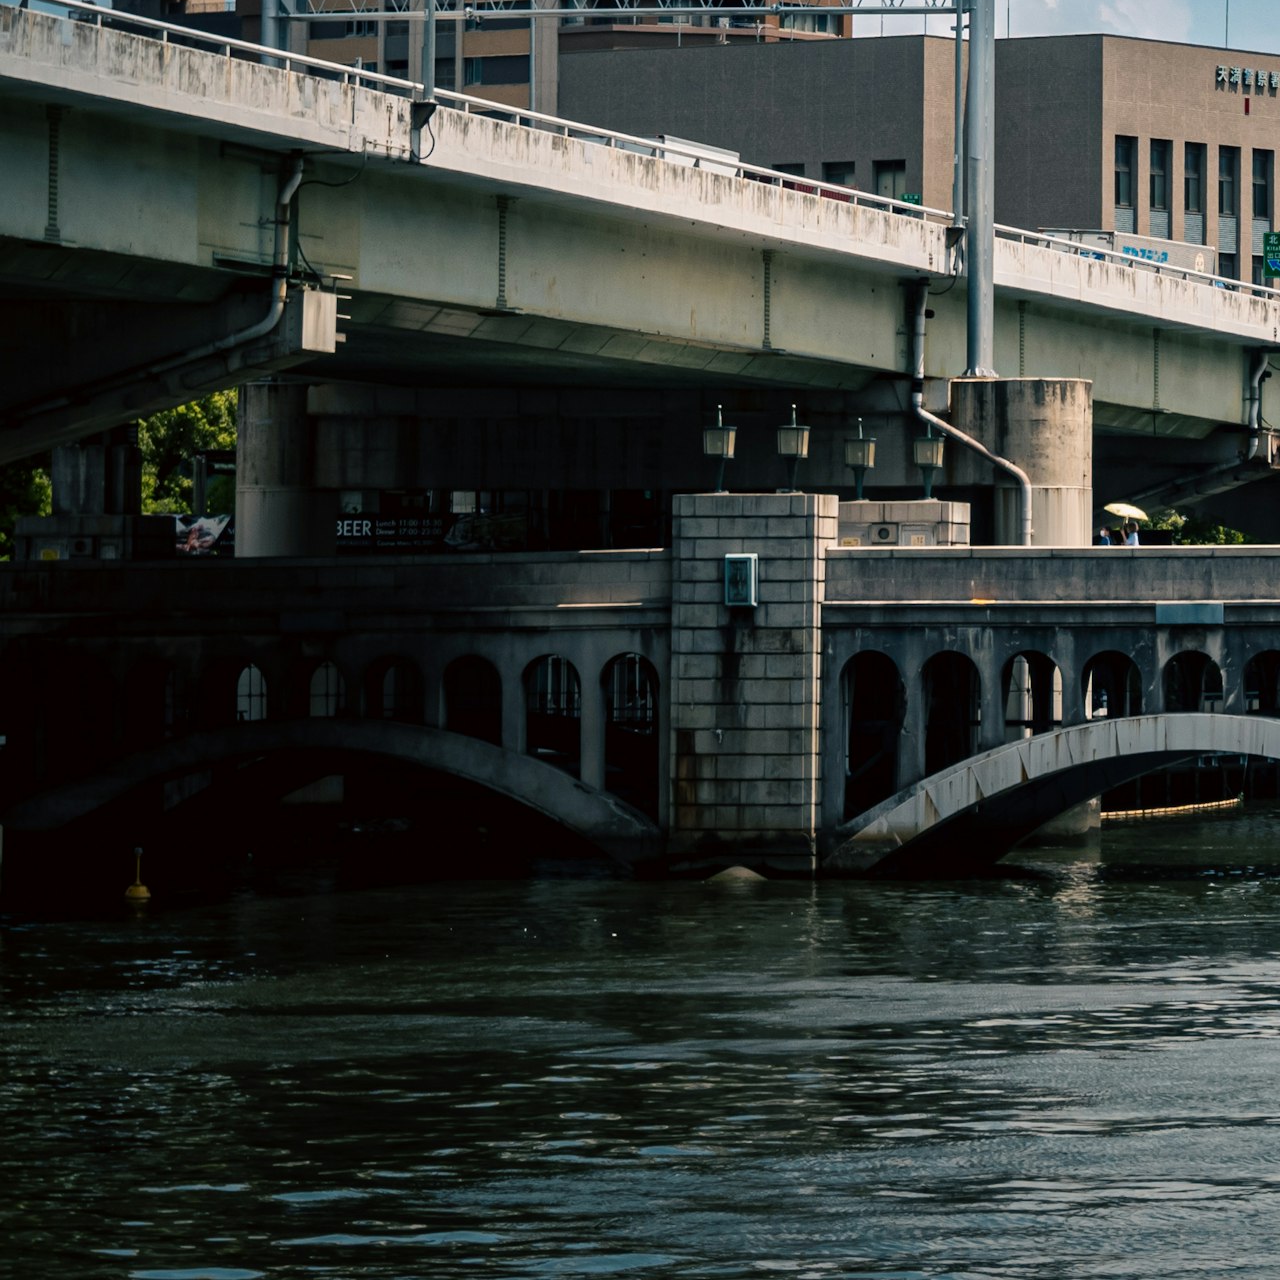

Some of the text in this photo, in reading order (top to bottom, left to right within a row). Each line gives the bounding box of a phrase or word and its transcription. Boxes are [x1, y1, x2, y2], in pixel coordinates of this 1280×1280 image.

[1216, 65, 1280, 88] 天満警察署
